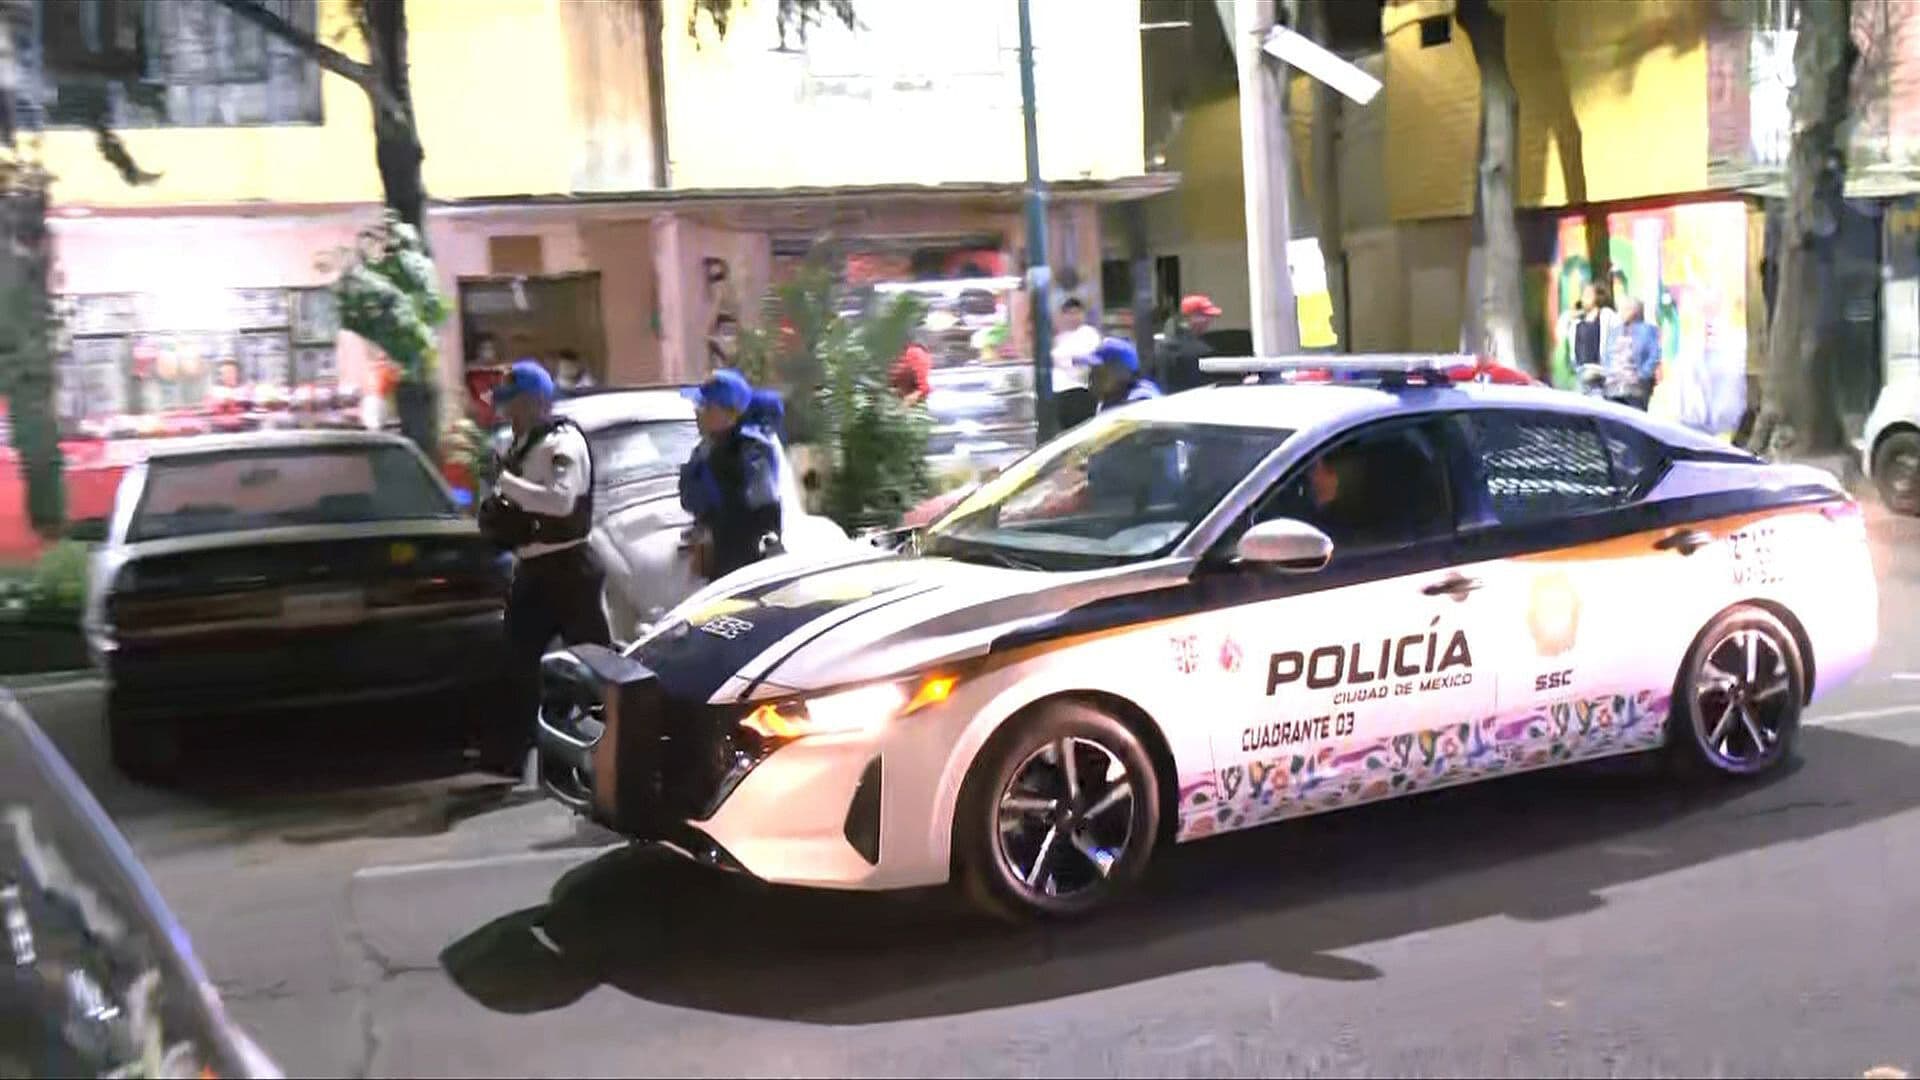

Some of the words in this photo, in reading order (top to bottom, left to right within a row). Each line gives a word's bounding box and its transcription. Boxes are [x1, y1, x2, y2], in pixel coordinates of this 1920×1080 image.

[1266, 615, 1472, 695] POLICÍA
[1333, 686, 1388, 705] CIUDAD
[1394, 682, 1413, 696] DE
[1535, 668, 1574, 691] SSC
[1242, 716, 1330, 752] CUADRANTE
[1335, 711, 1355, 737] 03
